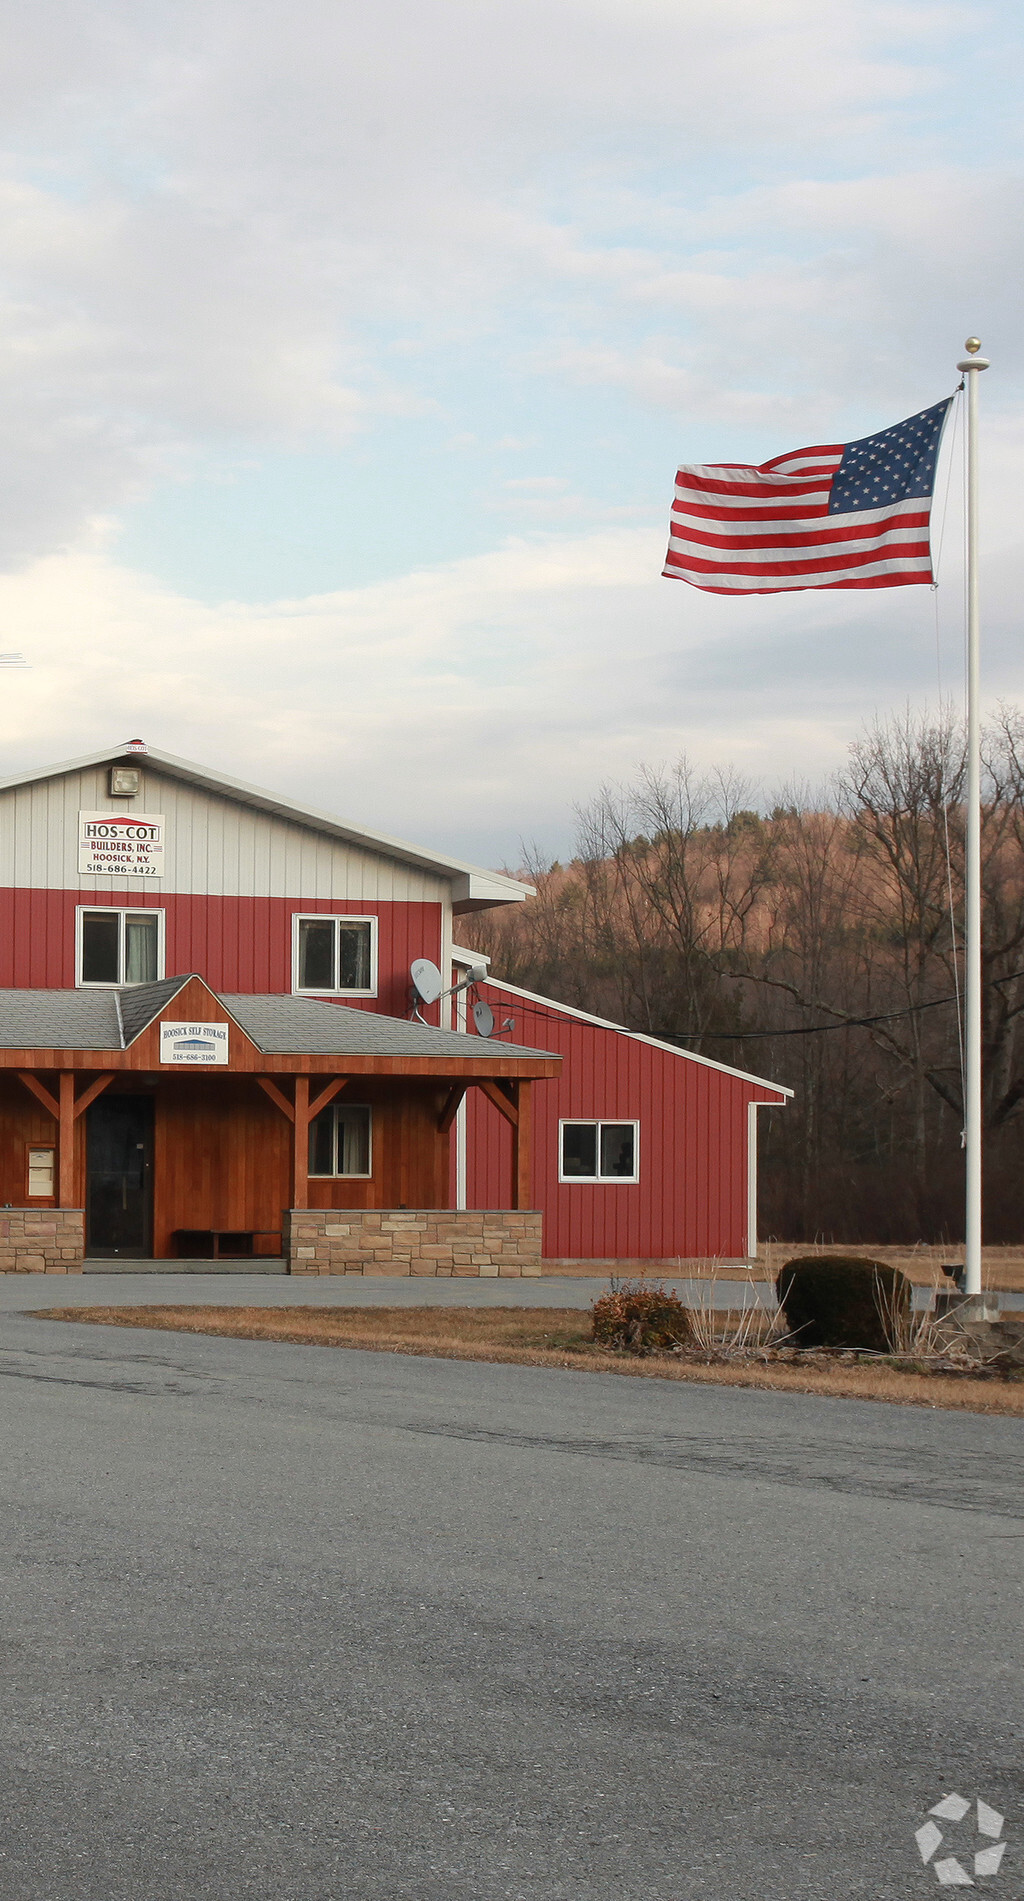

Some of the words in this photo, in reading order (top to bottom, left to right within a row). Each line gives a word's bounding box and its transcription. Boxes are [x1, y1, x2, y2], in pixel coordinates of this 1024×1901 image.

[87, 825, 156, 839] HOS-COT
[91, 841, 134, 853] BUILDERS,
[136, 843, 153, 853] INC.
[93, 853, 134, 863] HOOSICK,
[87, 864, 156, 874] 518-686-4422
[163, 1027, 187, 1039] HOOSICK
[189, 1027, 201, 1035] SELF
[203, 1028, 226, 1040] STORAGE
